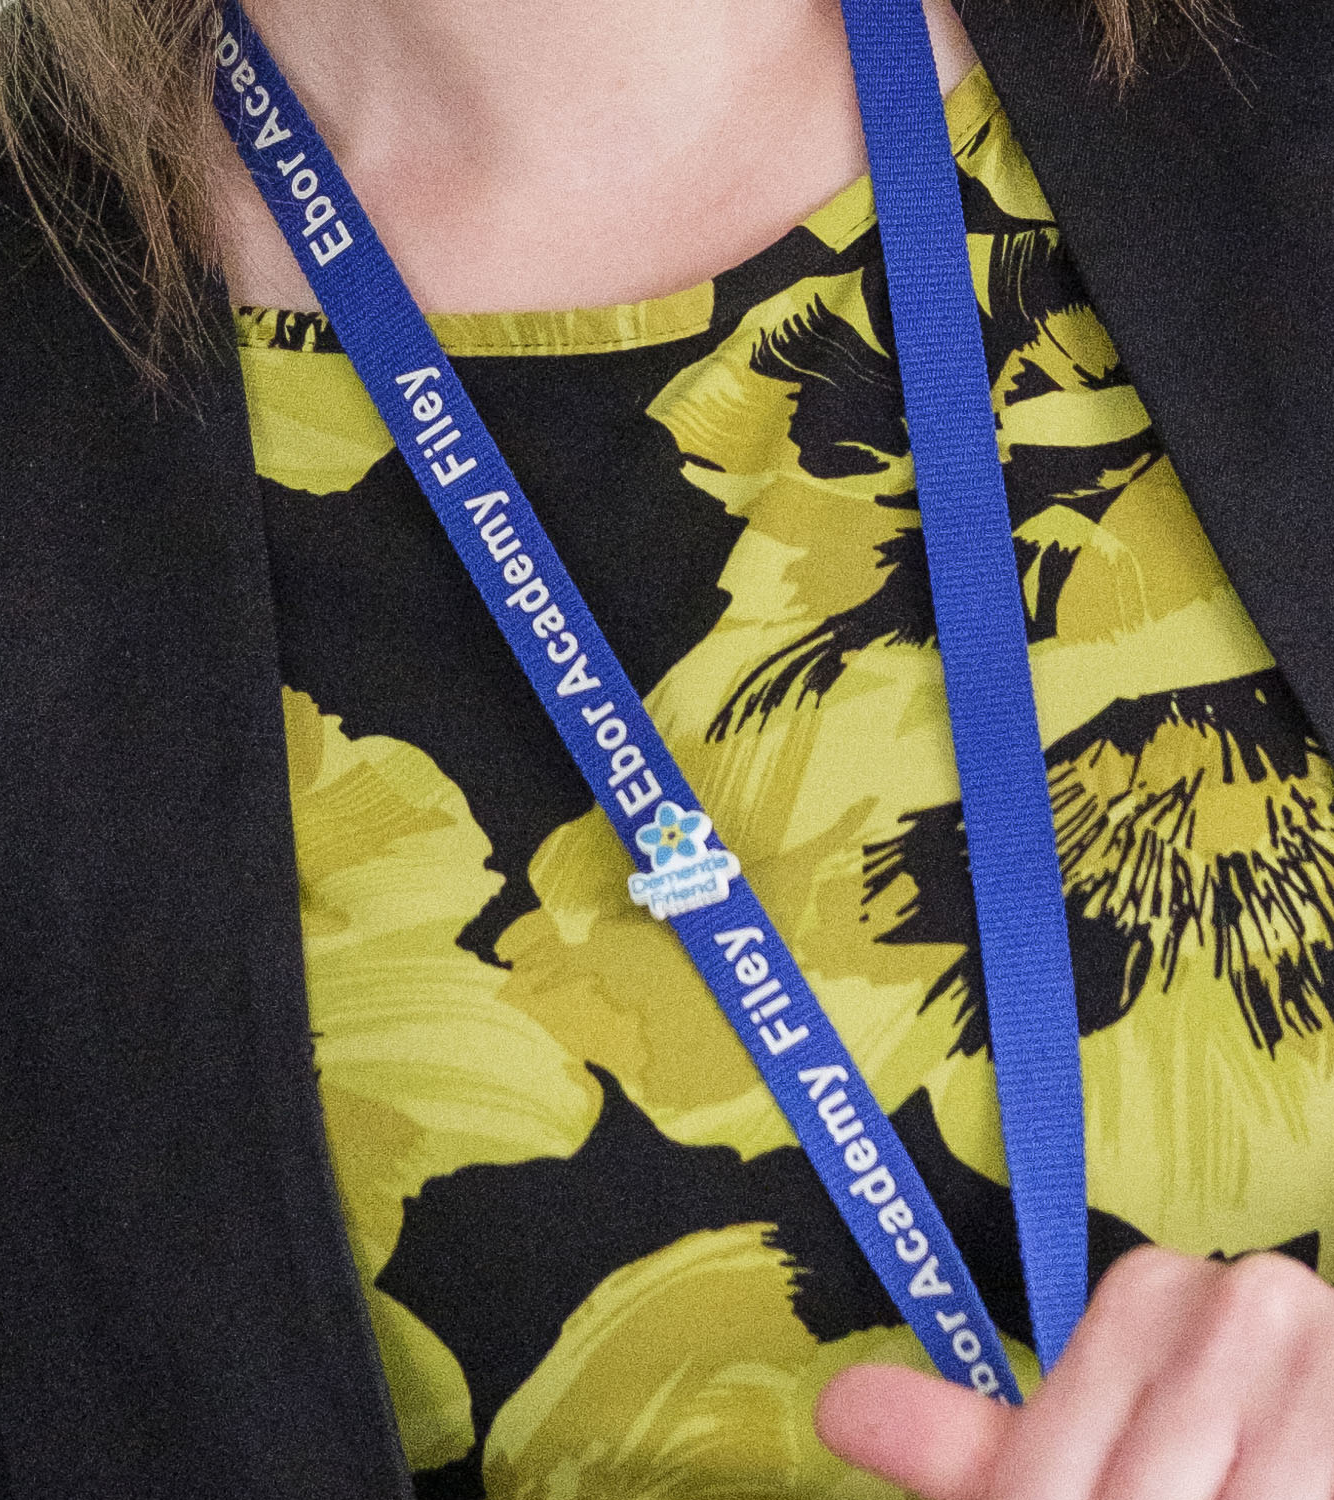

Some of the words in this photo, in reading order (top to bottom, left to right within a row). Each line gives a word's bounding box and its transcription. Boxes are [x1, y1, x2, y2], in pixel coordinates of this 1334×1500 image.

[275, 150, 355, 268] Ebor
[395, 365, 479, 488] Filey
[463, 489, 603, 698] Academy
[581, 699, 665, 819] Ebor
[713, 925, 811, 1056] Filey
[798, 1062, 955, 1299] Academy
[935, 1310, 1009, 1404] bor
